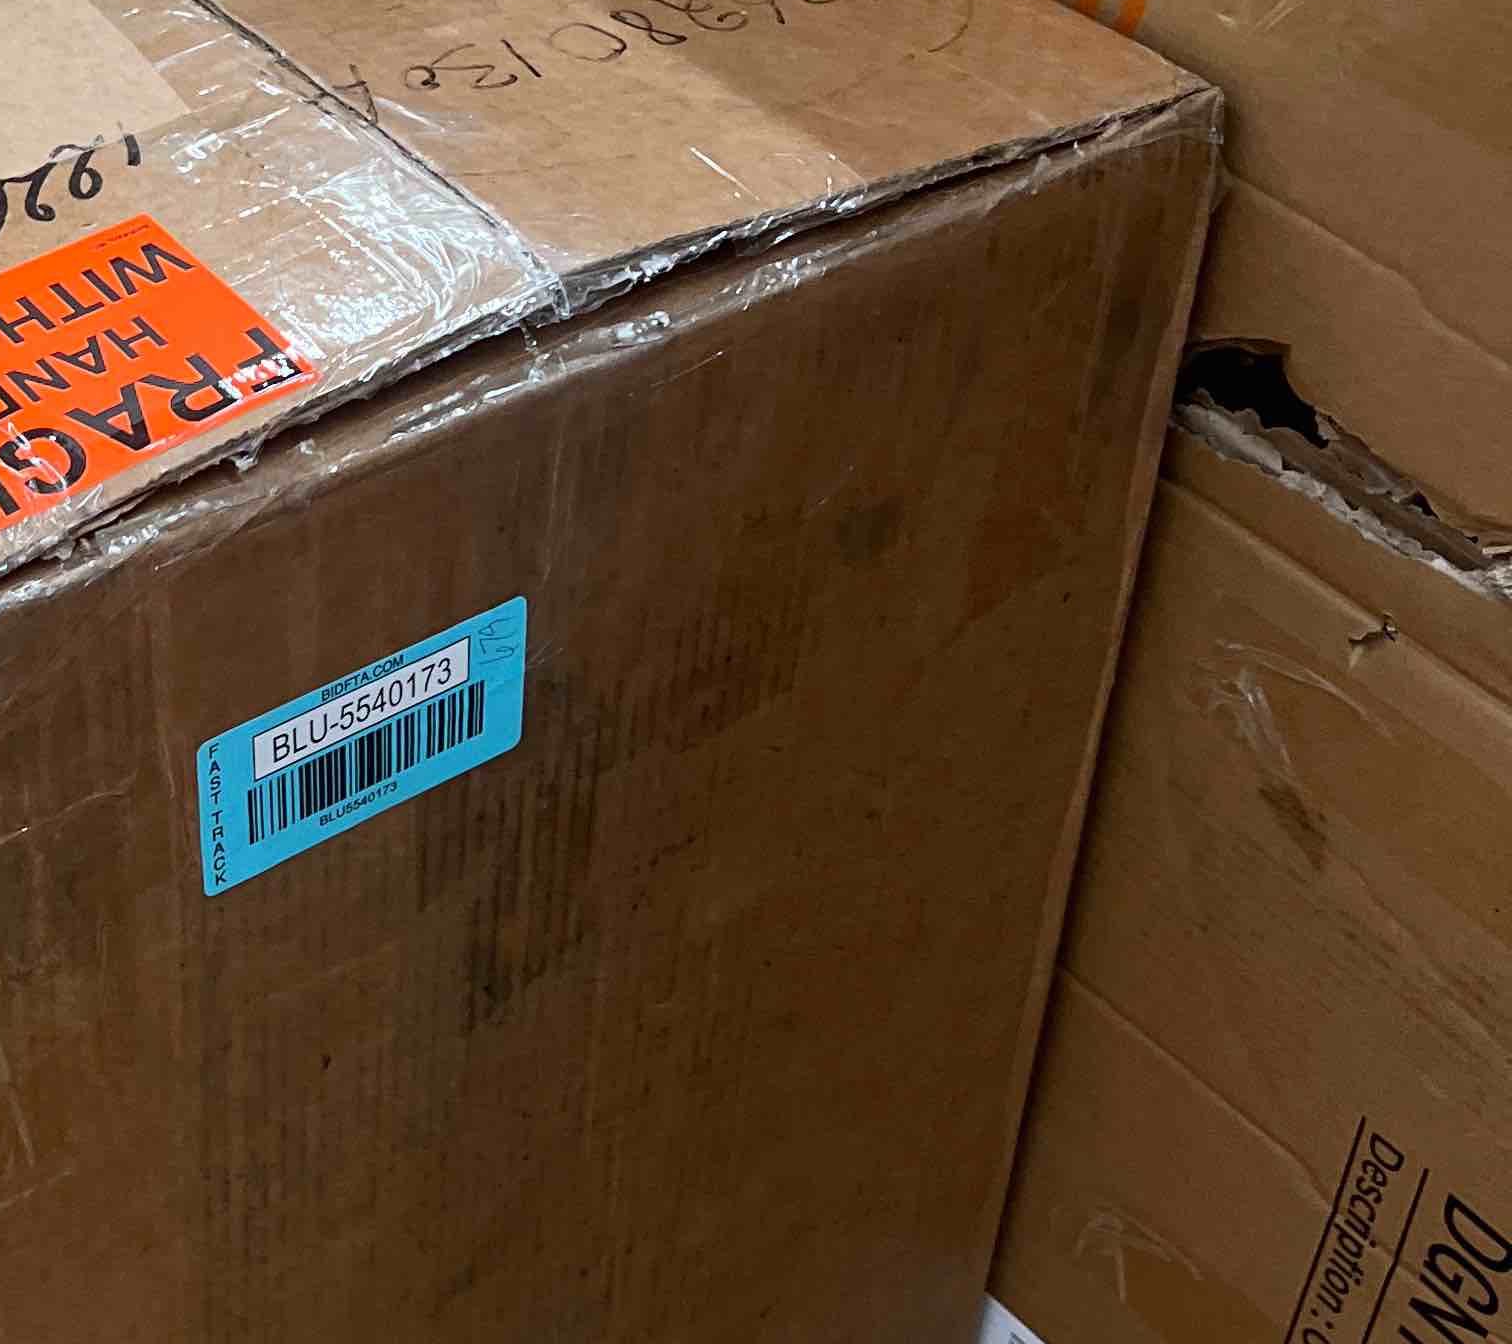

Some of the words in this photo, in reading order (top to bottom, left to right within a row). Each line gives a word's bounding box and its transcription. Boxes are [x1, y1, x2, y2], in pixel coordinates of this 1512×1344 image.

[321, 655, 404, 701] BIDFTA.COM
[273, 657, 452, 763] BLU-5540173
[209, 744, 222, 801] FAST
[320, 783, 397, 826] BLU5540173
[212, 812, 227, 886] TRACK
